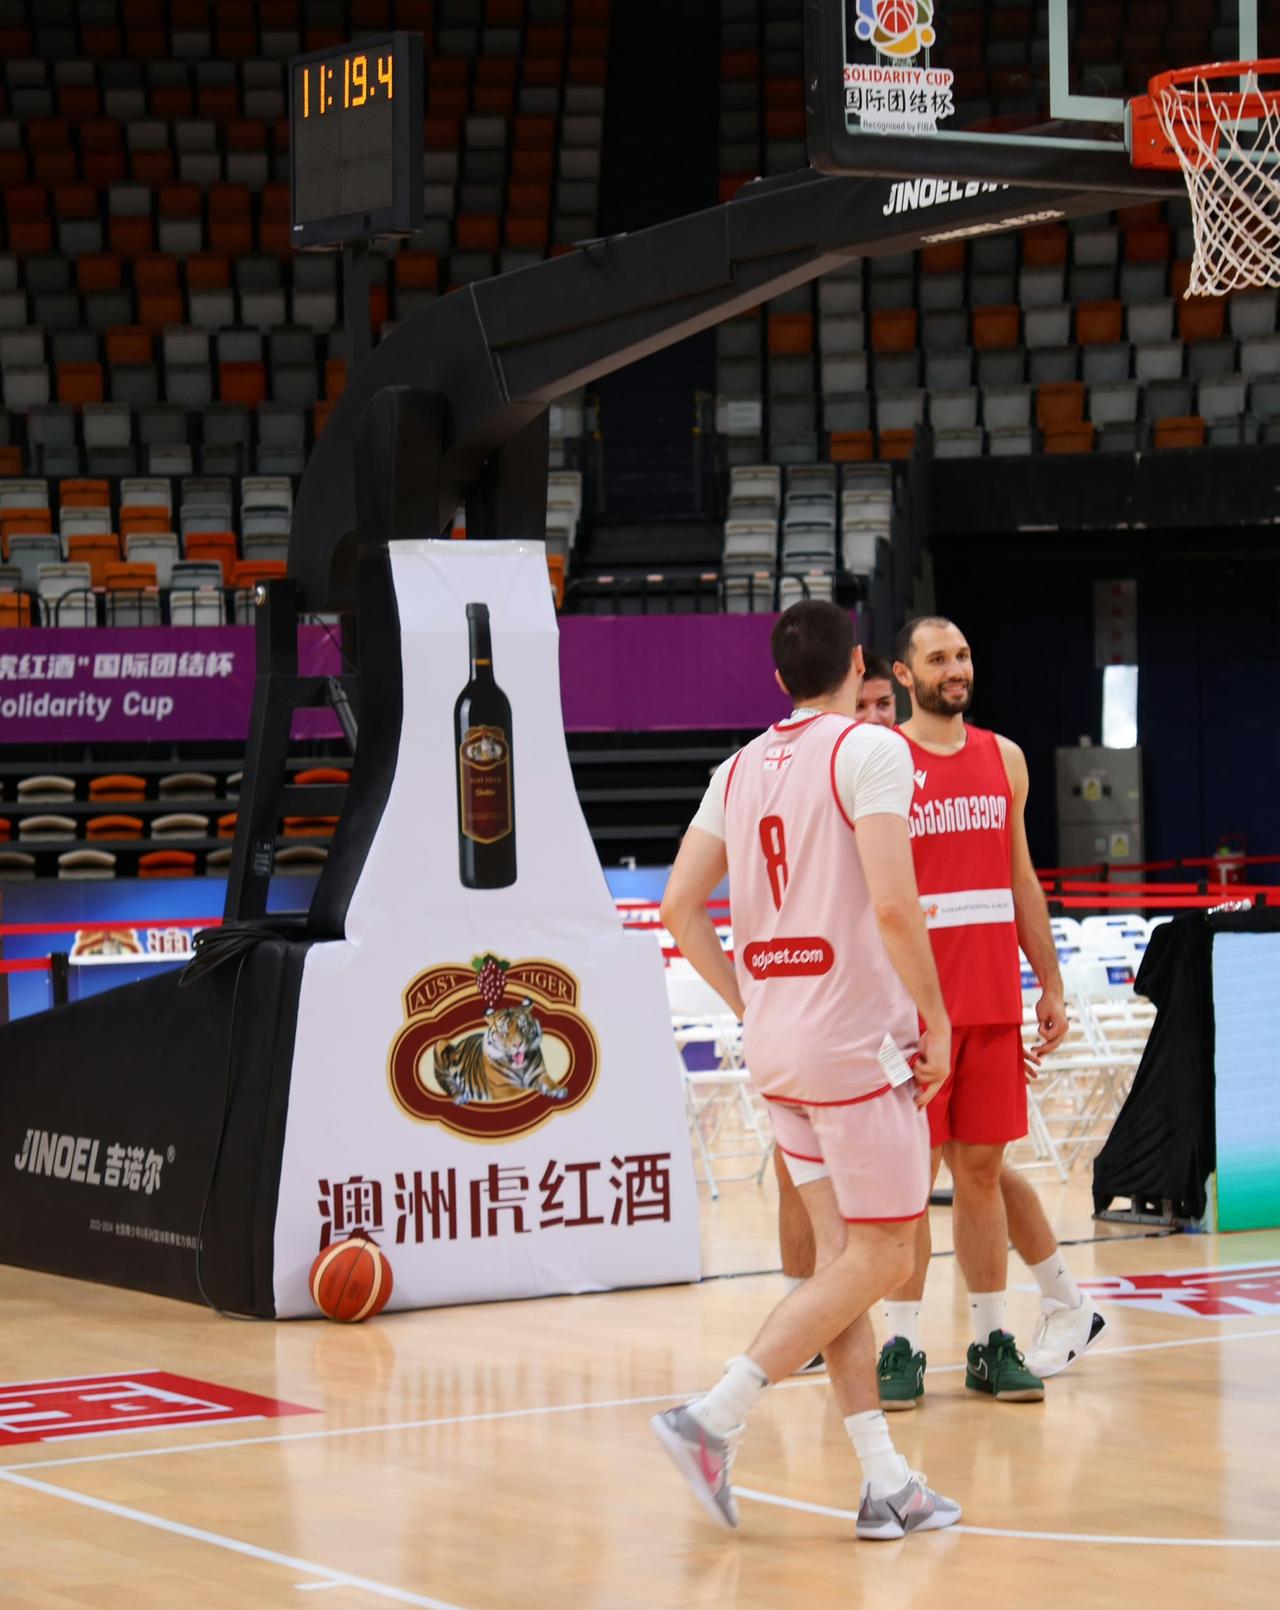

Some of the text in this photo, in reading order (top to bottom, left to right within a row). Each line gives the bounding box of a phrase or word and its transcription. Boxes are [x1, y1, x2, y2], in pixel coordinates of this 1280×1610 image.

[843, 67, 951, 86] SOLIDARITY CUP
[845, 87, 951, 114] 国际团结杯
[863, 120, 935, 132] Recognised by FIBA
[883, 178, 963, 216] JINOEL
[0, 691, 174, 722] olidarity Cup
[415, 971, 568, 1009] AUST TIGER
[15, 1129, 101, 1185] JINOEL
[104, 1143, 164, 1194] 吉诺尔
[317, 1152, 671, 1251] 澳洲虎红酒
